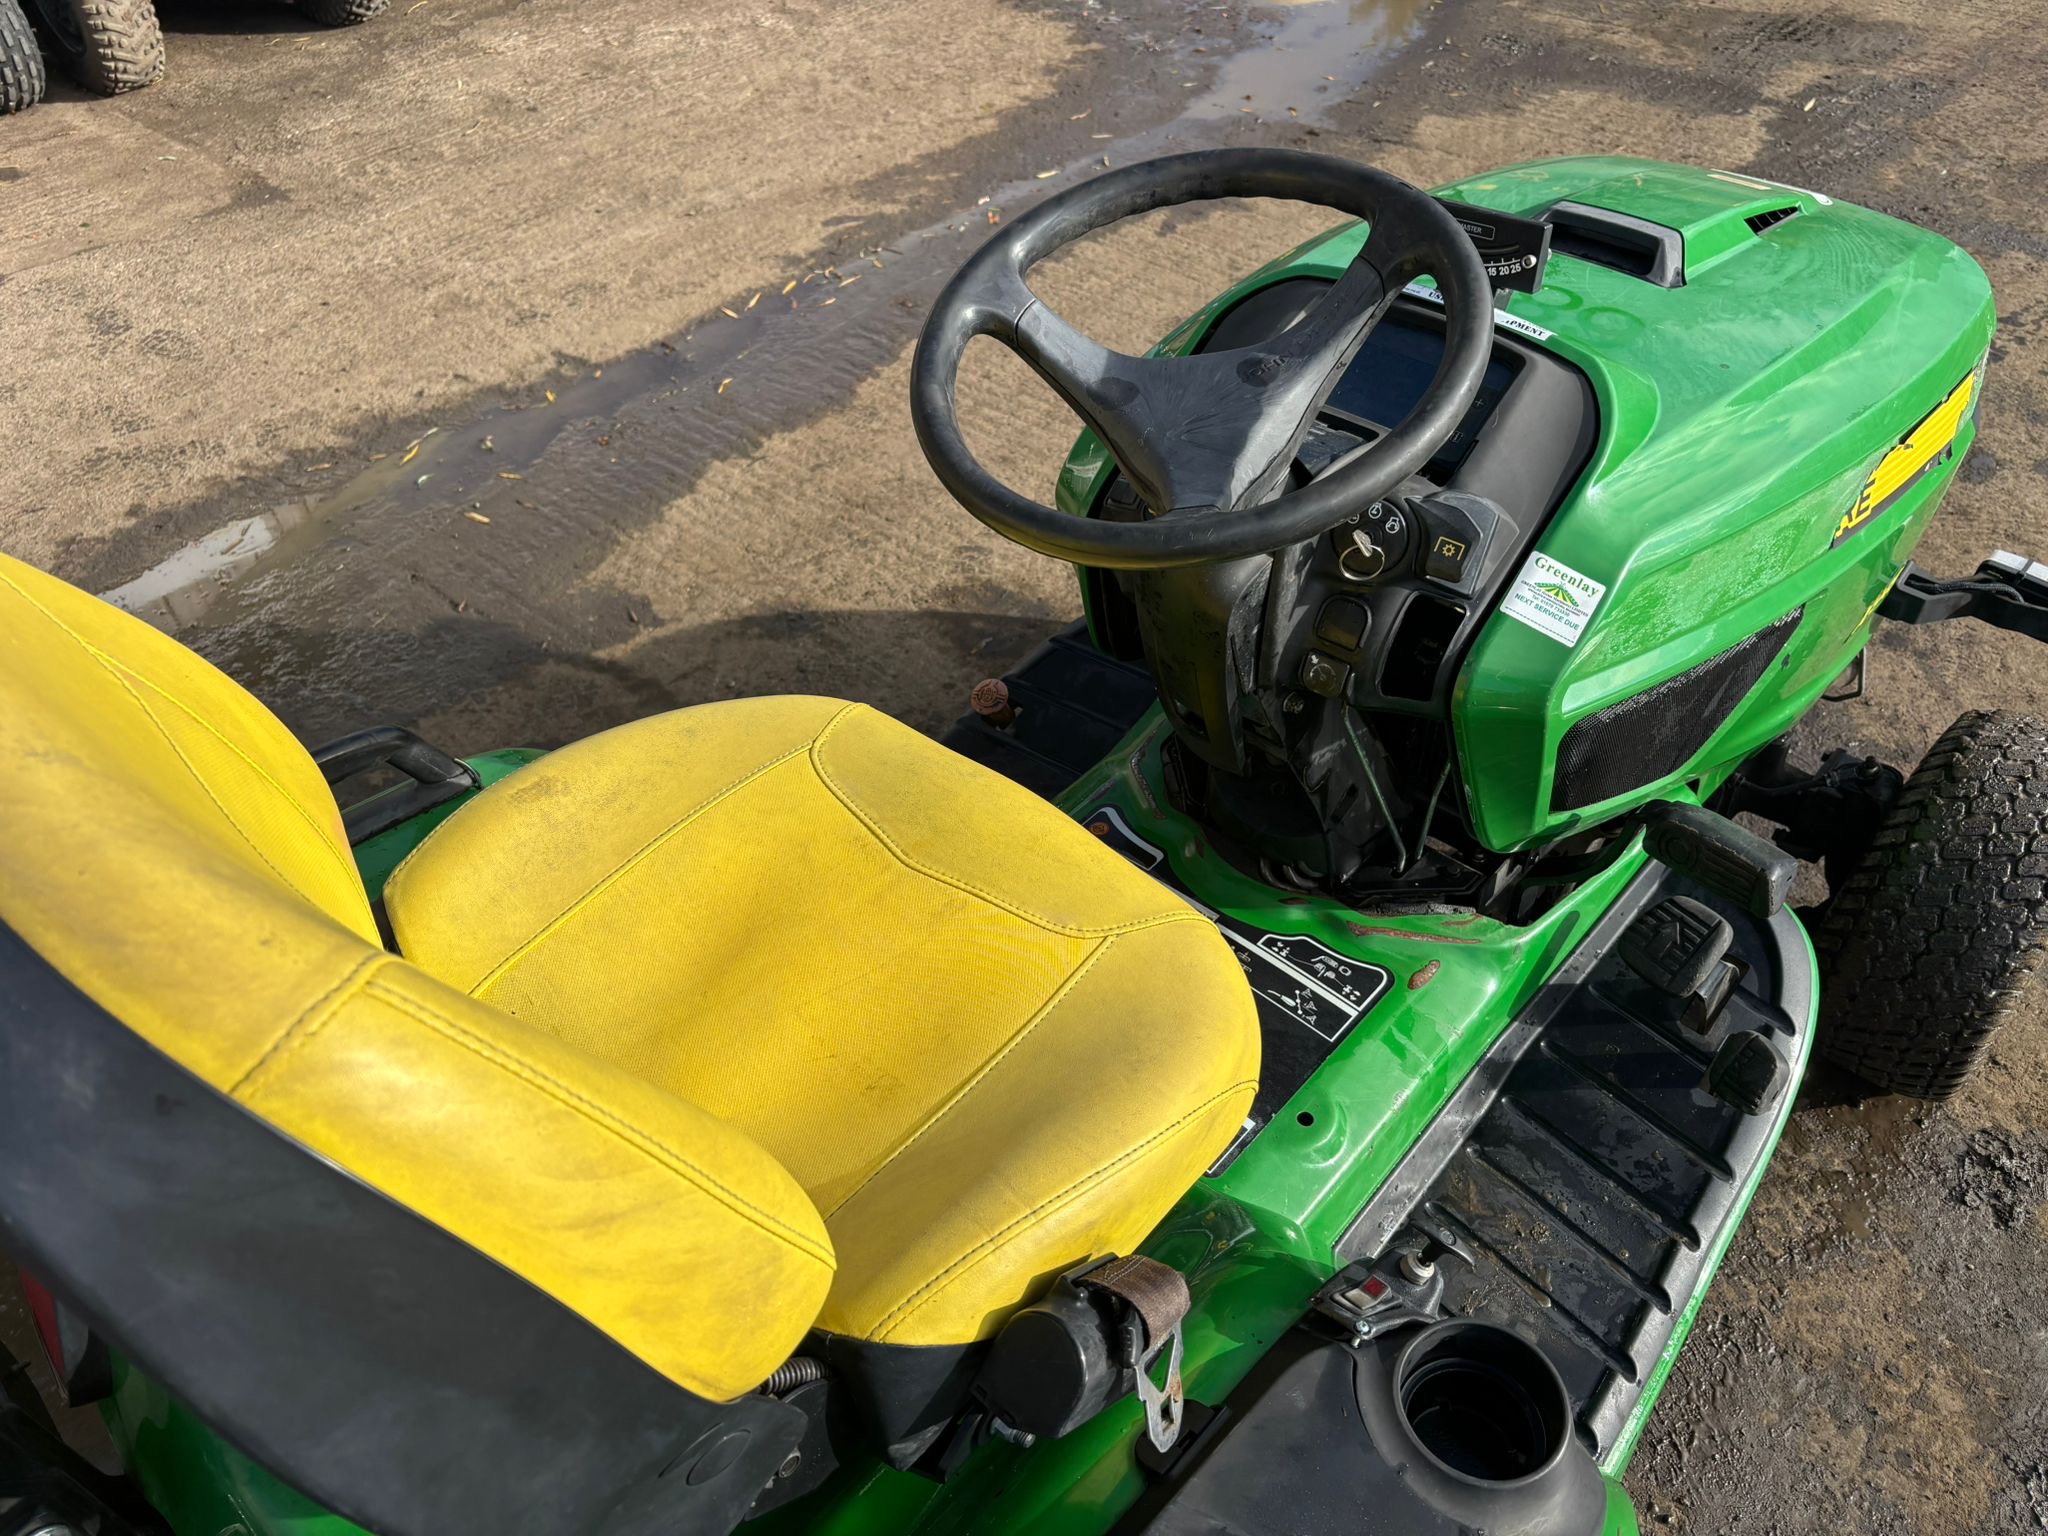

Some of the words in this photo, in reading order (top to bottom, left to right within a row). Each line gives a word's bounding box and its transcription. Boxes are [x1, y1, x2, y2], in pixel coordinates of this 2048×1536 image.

[1487, 267, 1497, 276] 15
[1499, 265, 1509, 275] 20
[1510, 264, 1521, 273] 25
[1535, 556, 1600, 598] Greenlay
[1514, 593, 1533, 607] NEXT
[1533, 603, 1565, 624] SERVICE
[1564, 618, 1580, 631] DUE
